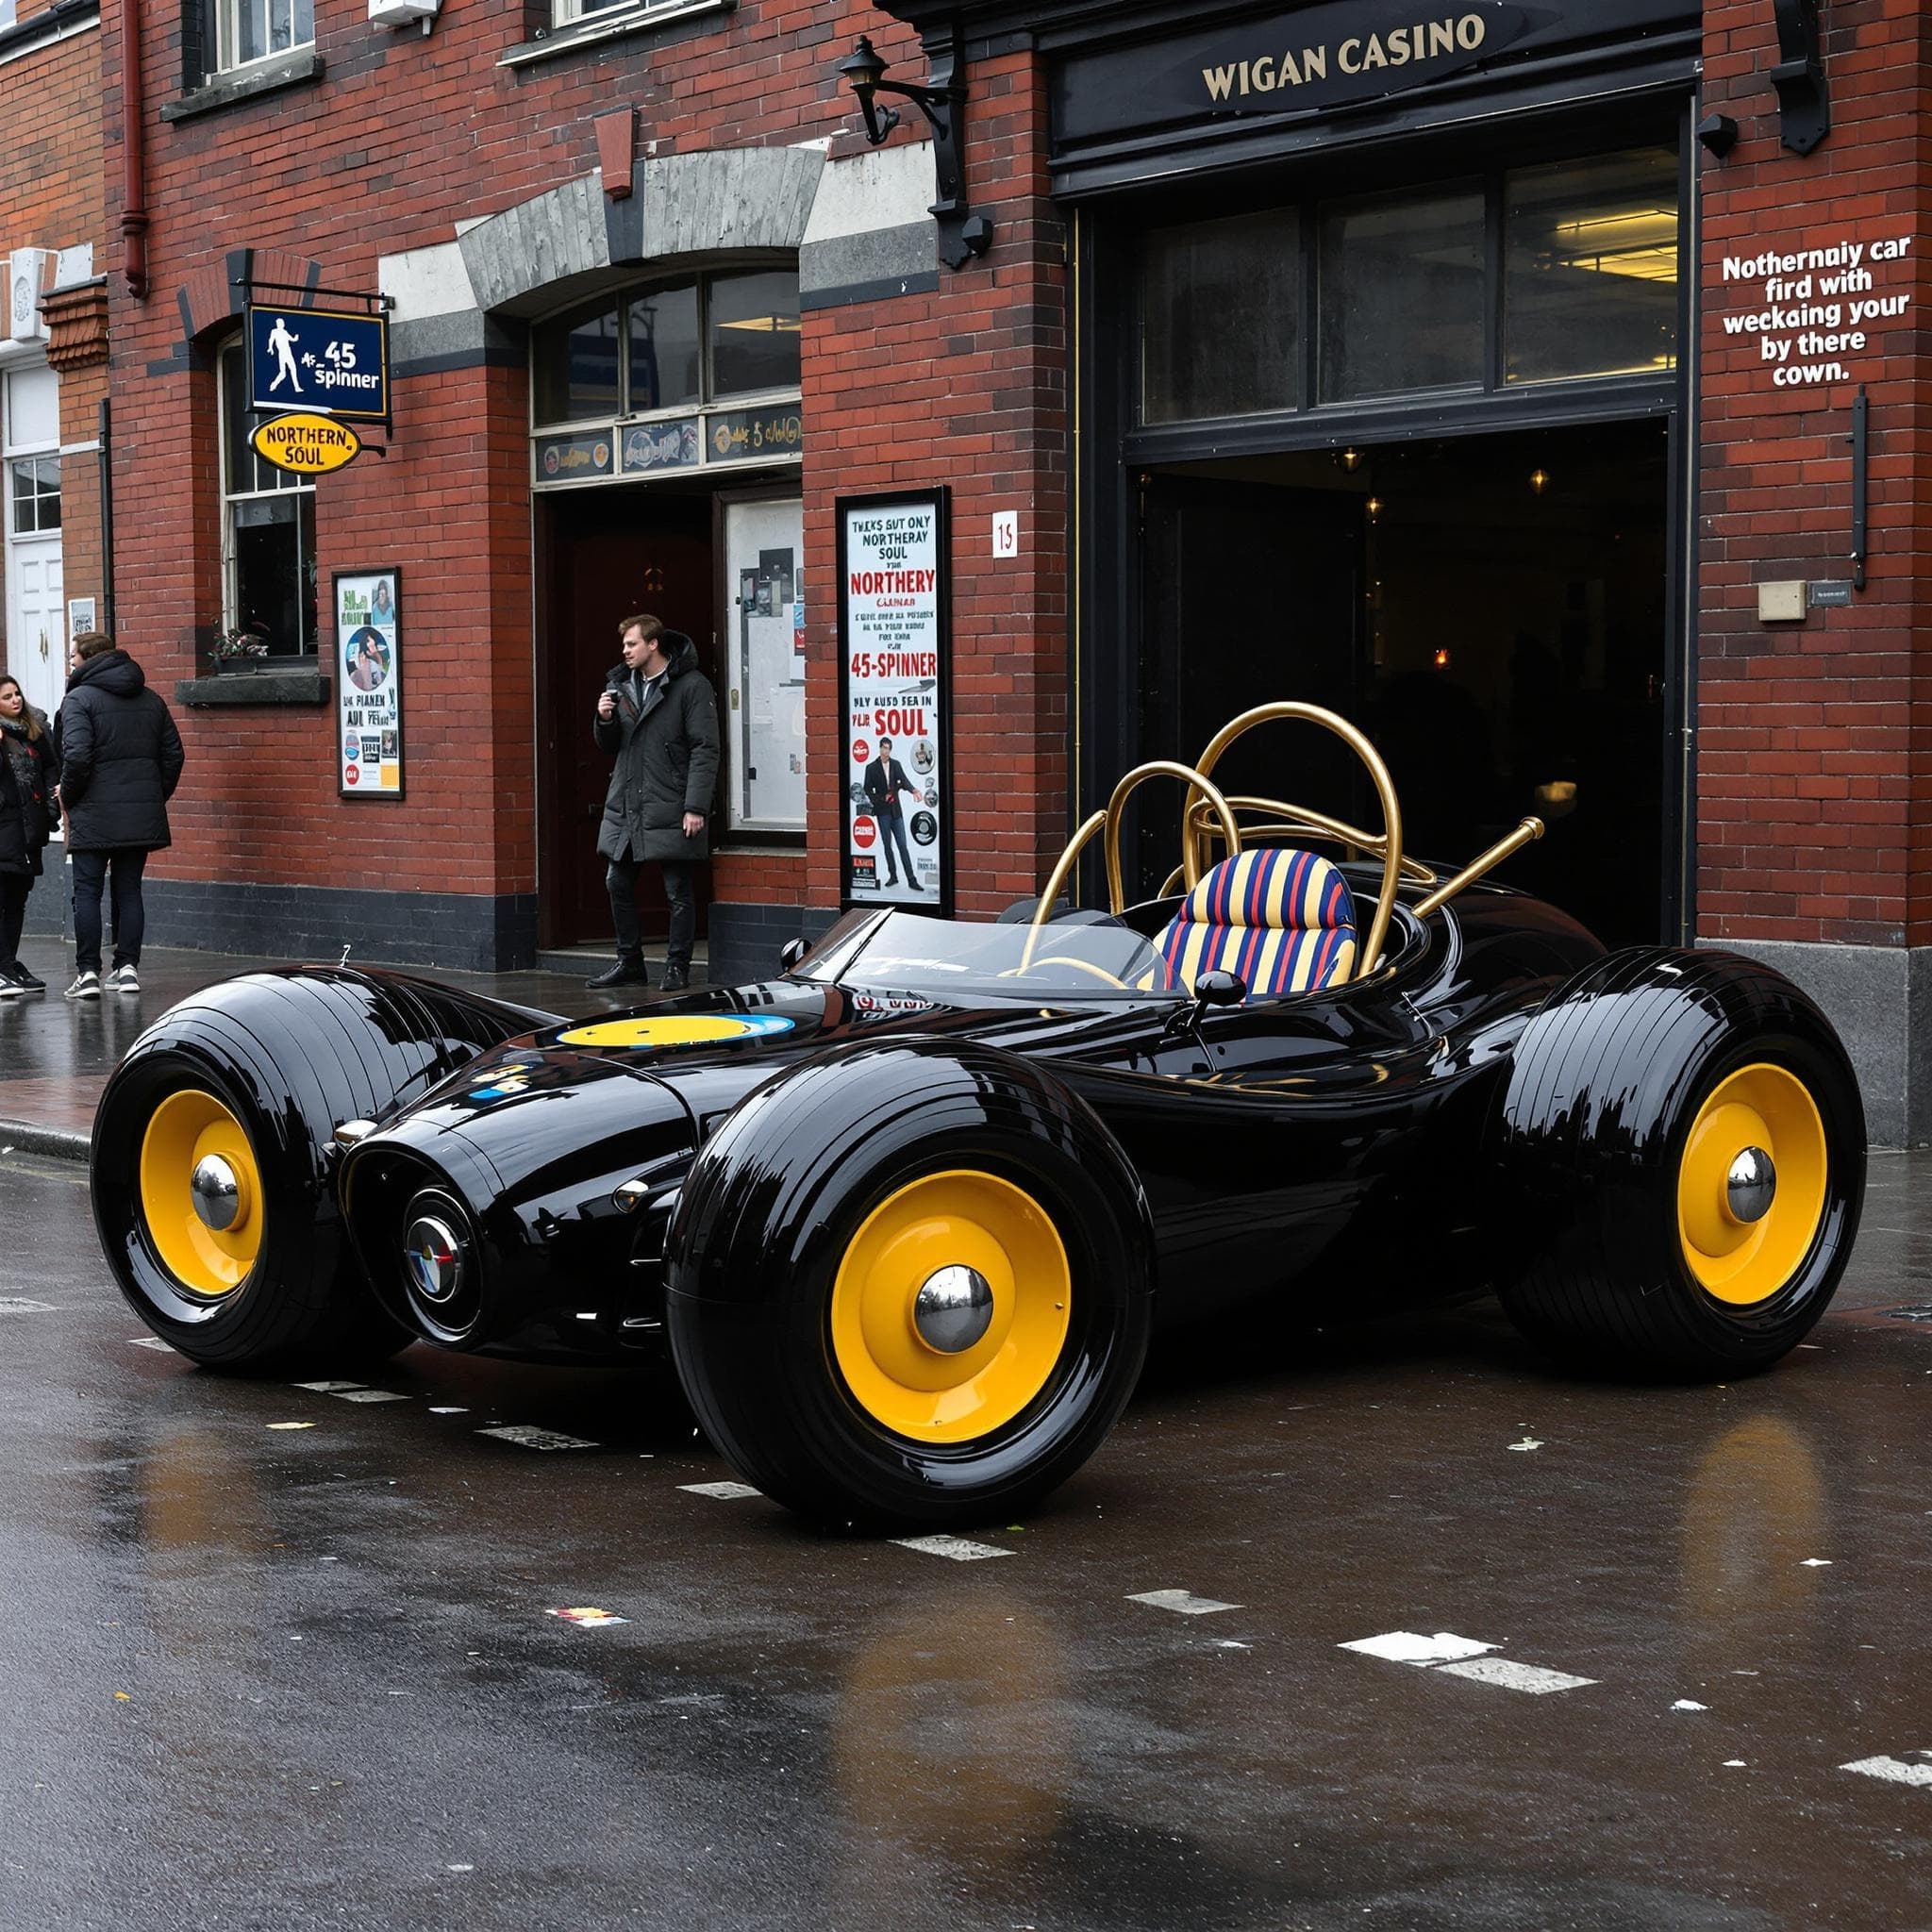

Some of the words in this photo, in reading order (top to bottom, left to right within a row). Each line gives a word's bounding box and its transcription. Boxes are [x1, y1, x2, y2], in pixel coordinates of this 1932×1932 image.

[1202, 45, 1326, 101] WIGAN
[1337, 13, 1486, 74] CASINO
[1870, 237, 1911, 261] car
[1765, 275, 1812, 302] fird
[1819, 268, 1873, 296] with
[1849, 294, 1910, 325] your
[325, 341, 357, 369] 45
[1761, 336, 1791, 362] by
[1797, 331, 1866, 356] there
[1773, 361, 1850, 386] cown.
[267, 426, 347, 446] NORTHERN
[285, 446, 325, 465] SOUL
[878, 546, 908, 559] SOUL
[851, 569, 935, 595] NORTHERY
[851, 652, 936, 677] 45-SPINNER
[874, 709, 928, 736] SOUL
